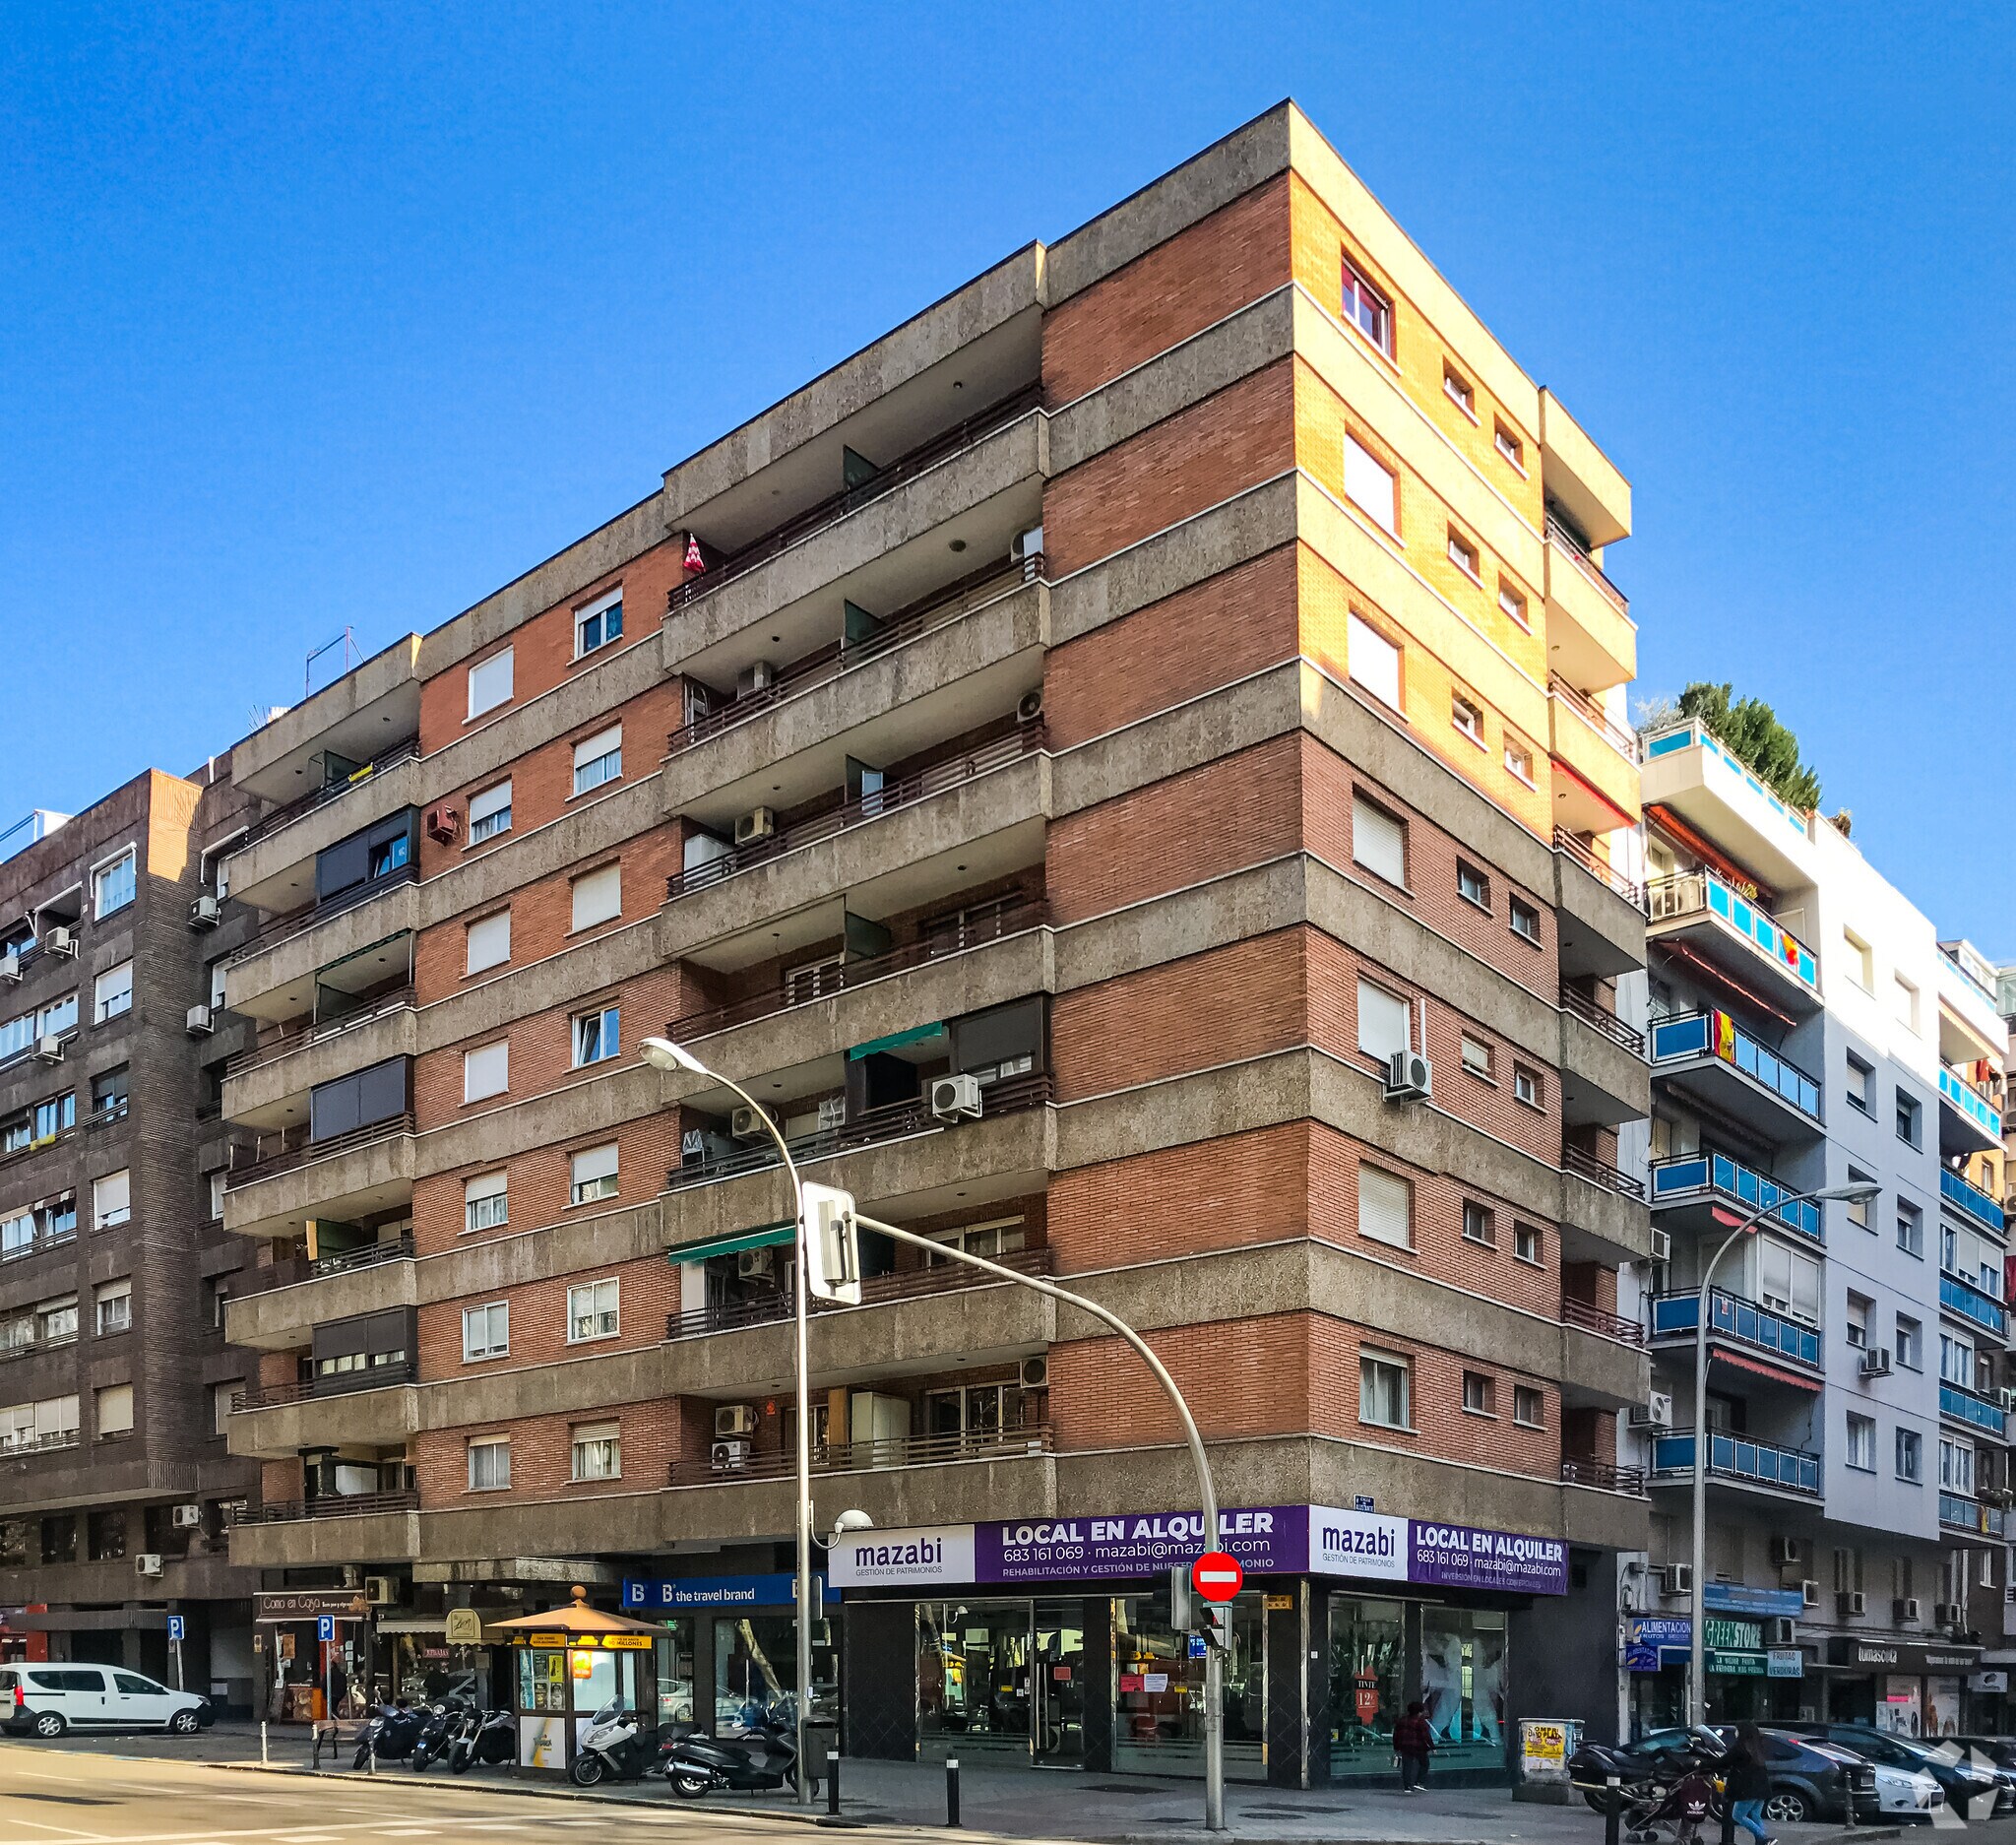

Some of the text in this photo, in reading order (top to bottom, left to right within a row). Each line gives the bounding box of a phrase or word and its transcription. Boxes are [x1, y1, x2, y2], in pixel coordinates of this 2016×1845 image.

[1002, 1512, 1274, 1546] LOCAL EN ALQULER
[1323, 1526, 1395, 1557] mazabi
[1417, 1525, 1563, 1561] LOCAL EN ALQUILER
[855, 1537, 942, 1566] mazabi
[1004, 1548, 1030, 1562] 683
[1033, 1547, 1051, 1560] 161
[1056, 1546, 1084, 1559] 069
[1002, 1564, 1081, 1577] REHABILITACIÓN
[1082, 1565, 1090, 1574] Y
[1091, 1561, 1133, 1573] GESTIÓN
[1135, 1562, 1150, 1572] DE
[1322, 1553, 1395, 1568] GESTIÓN DE PATRIMONIOS
[1418, 1549, 1561, 1577] 683 161 069 mazabi@mazabi.com
[855, 1565, 943, 1577] GESTIÓN DE PATRIMONIOS
[263, 1596, 285, 1610] Como
[286, 1599, 296, 1609] en
[675, 1590, 692, 1602] the
[693, 1589, 723, 1602] travel
[724, 1587, 755, 1601] brand
[170, 1619, 179, 1638] P
[320, 1618, 331, 1638] P
[1358, 1680, 1375, 1689] TINTE
